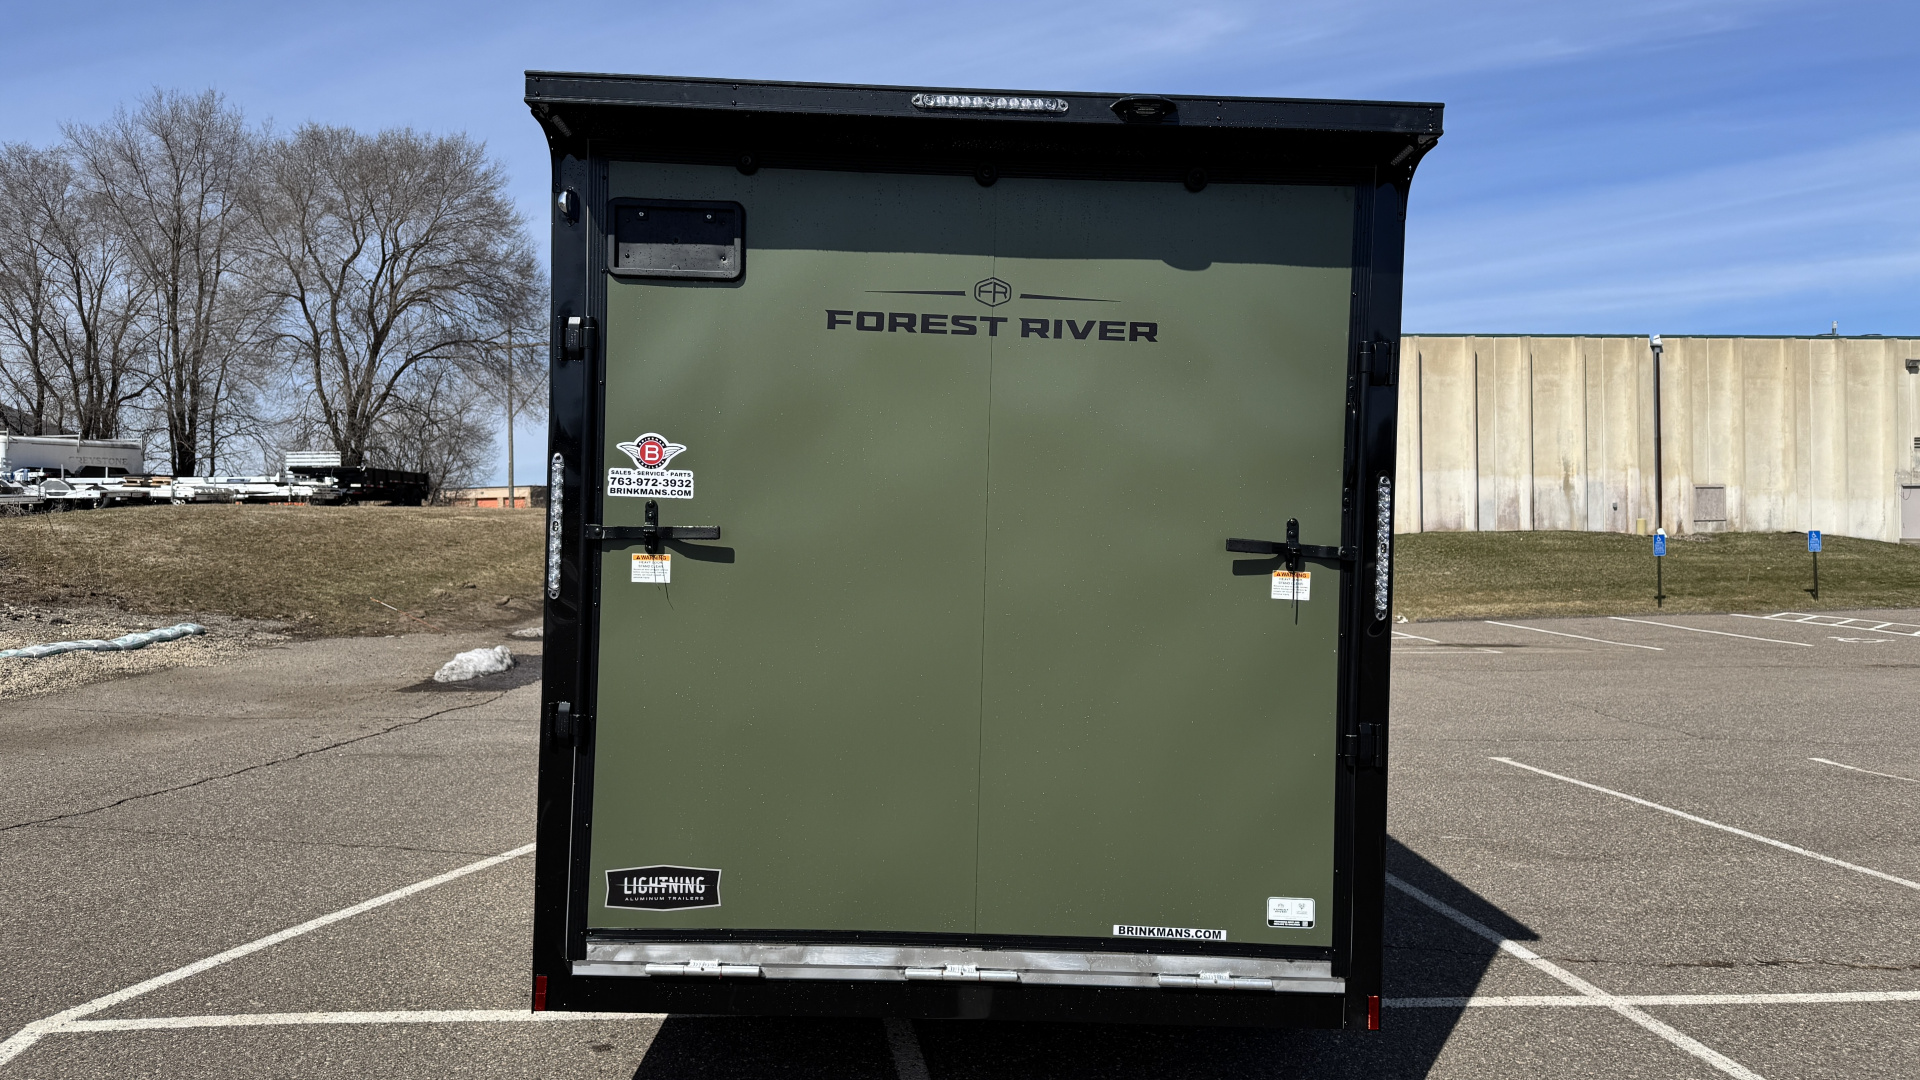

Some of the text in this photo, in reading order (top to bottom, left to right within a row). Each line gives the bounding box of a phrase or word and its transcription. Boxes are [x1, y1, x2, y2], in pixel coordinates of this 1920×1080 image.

[825, 309, 1158, 343] FOREST RIVER
[645, 445, 660, 460] B
[610, 477, 691, 487] 763-972-3932
[610, 488, 691, 496] BRINKMANS.COM
[624, 877, 705, 894] LIGHTNING
[1118, 925, 1222, 940] BRINKMANS.COM
